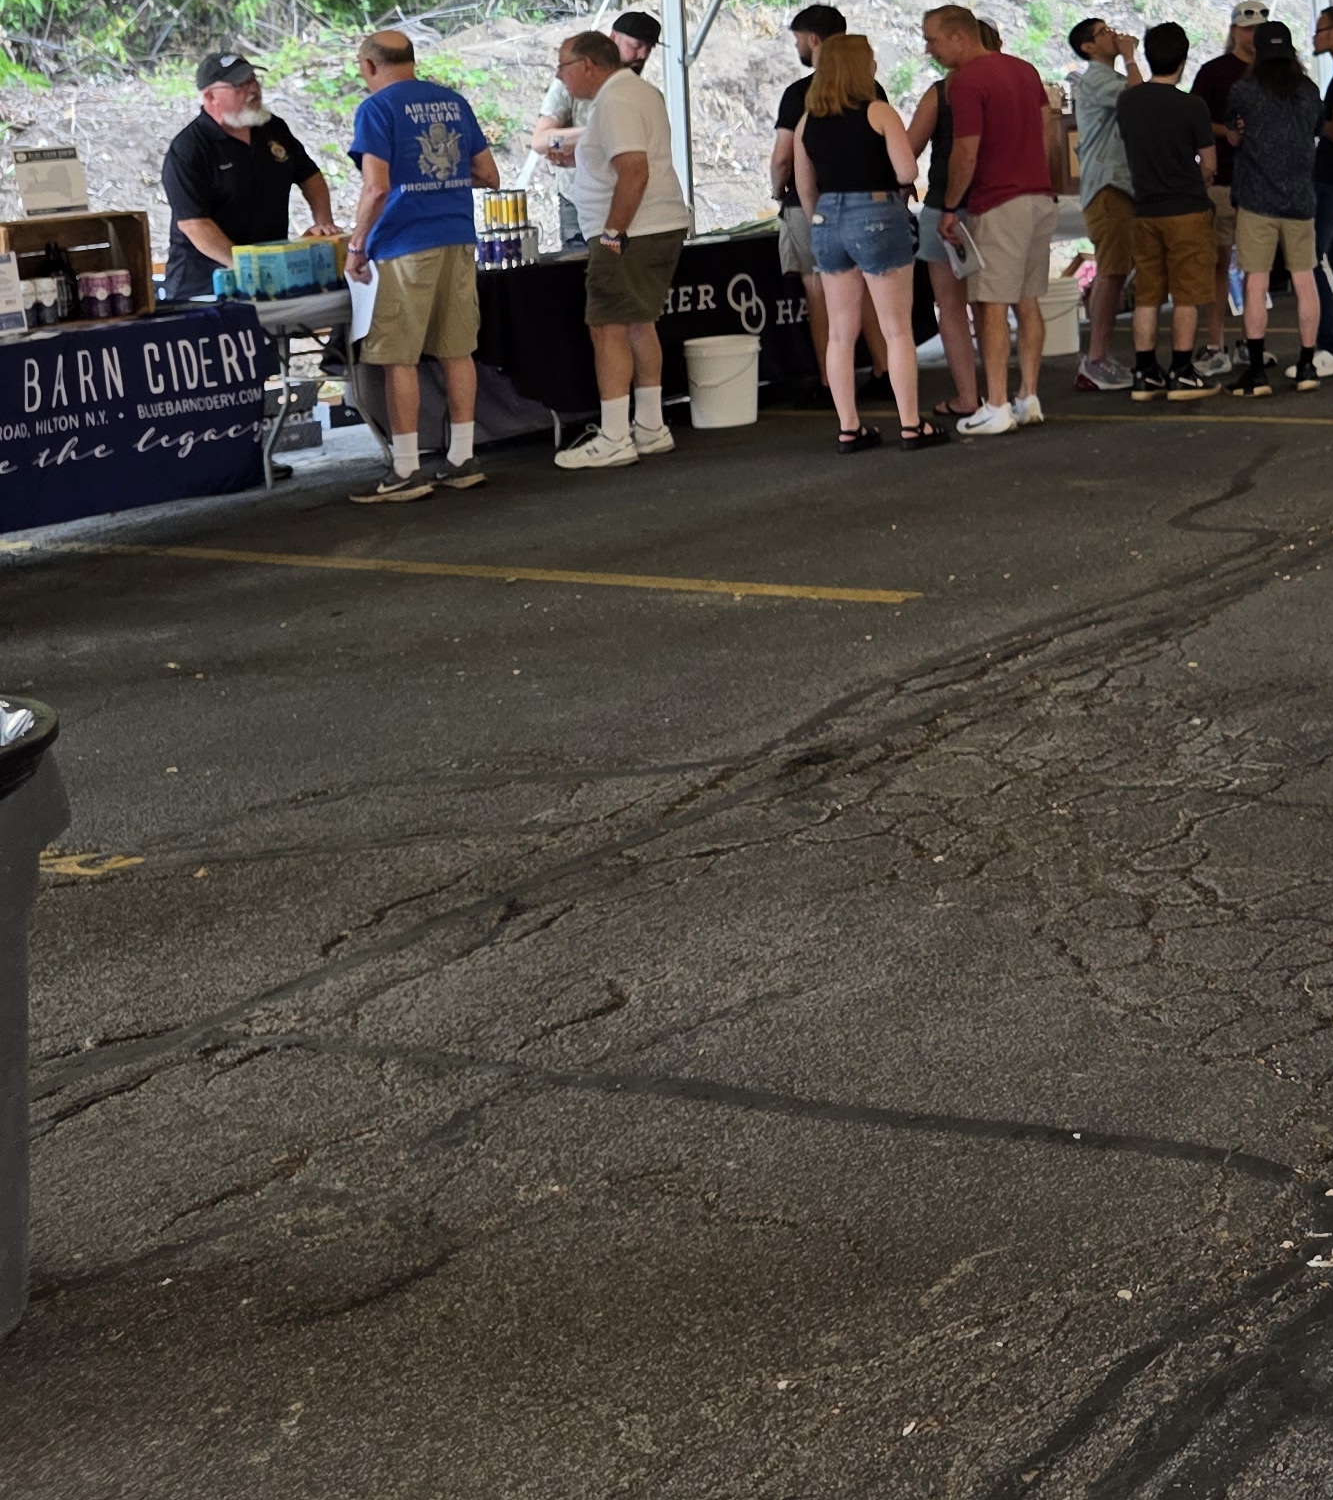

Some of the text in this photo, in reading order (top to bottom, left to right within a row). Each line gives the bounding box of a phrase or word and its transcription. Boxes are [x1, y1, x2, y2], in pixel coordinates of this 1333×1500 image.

[411, 112, 461, 124] VETERAN
[425, 101, 461, 114] FORCE
[24, 329, 257, 413] BARN CIDERY
[35, 413, 80, 436] HILTON
[85, 410, 110, 428] N.Y.
[32, 436, 115, 469] the
